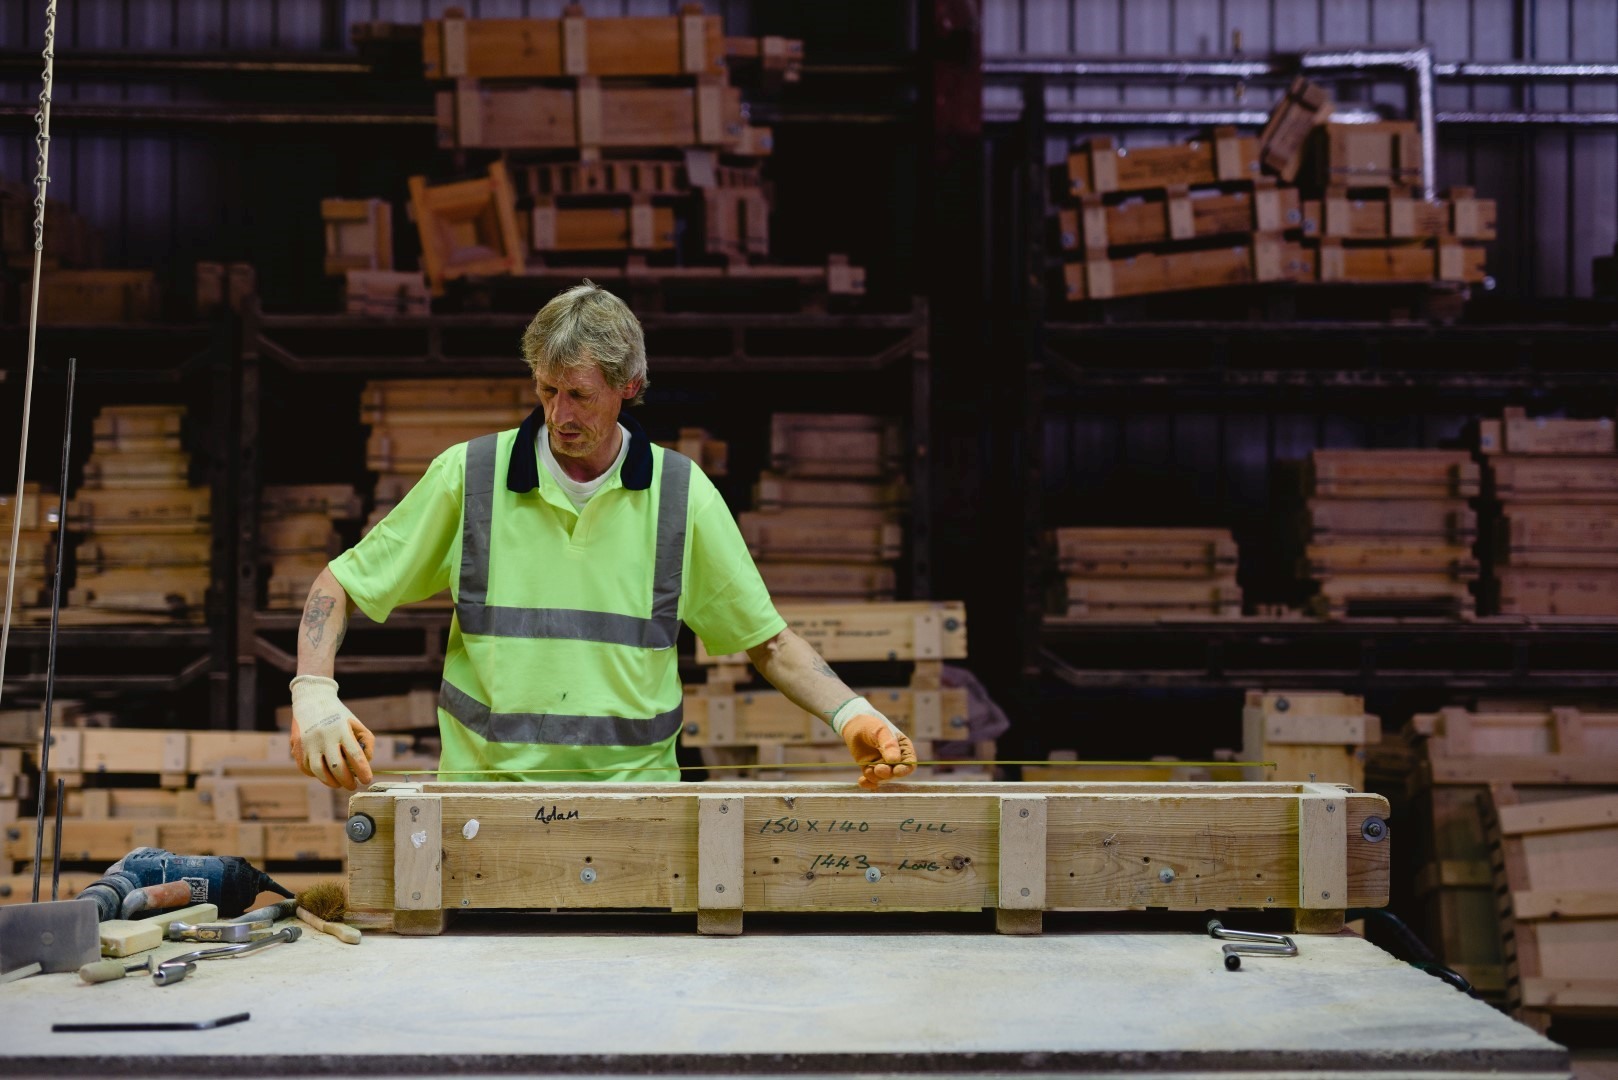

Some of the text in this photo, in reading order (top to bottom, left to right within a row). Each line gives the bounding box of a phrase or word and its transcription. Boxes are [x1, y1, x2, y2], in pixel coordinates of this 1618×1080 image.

[535, 805, 579, 824] Adam
[760, 816, 799, 834] 150
[827, 819, 870, 833] 140
[899, 818, 956, 834] CILL
[809, 853, 940, 872] 1443 LONG
